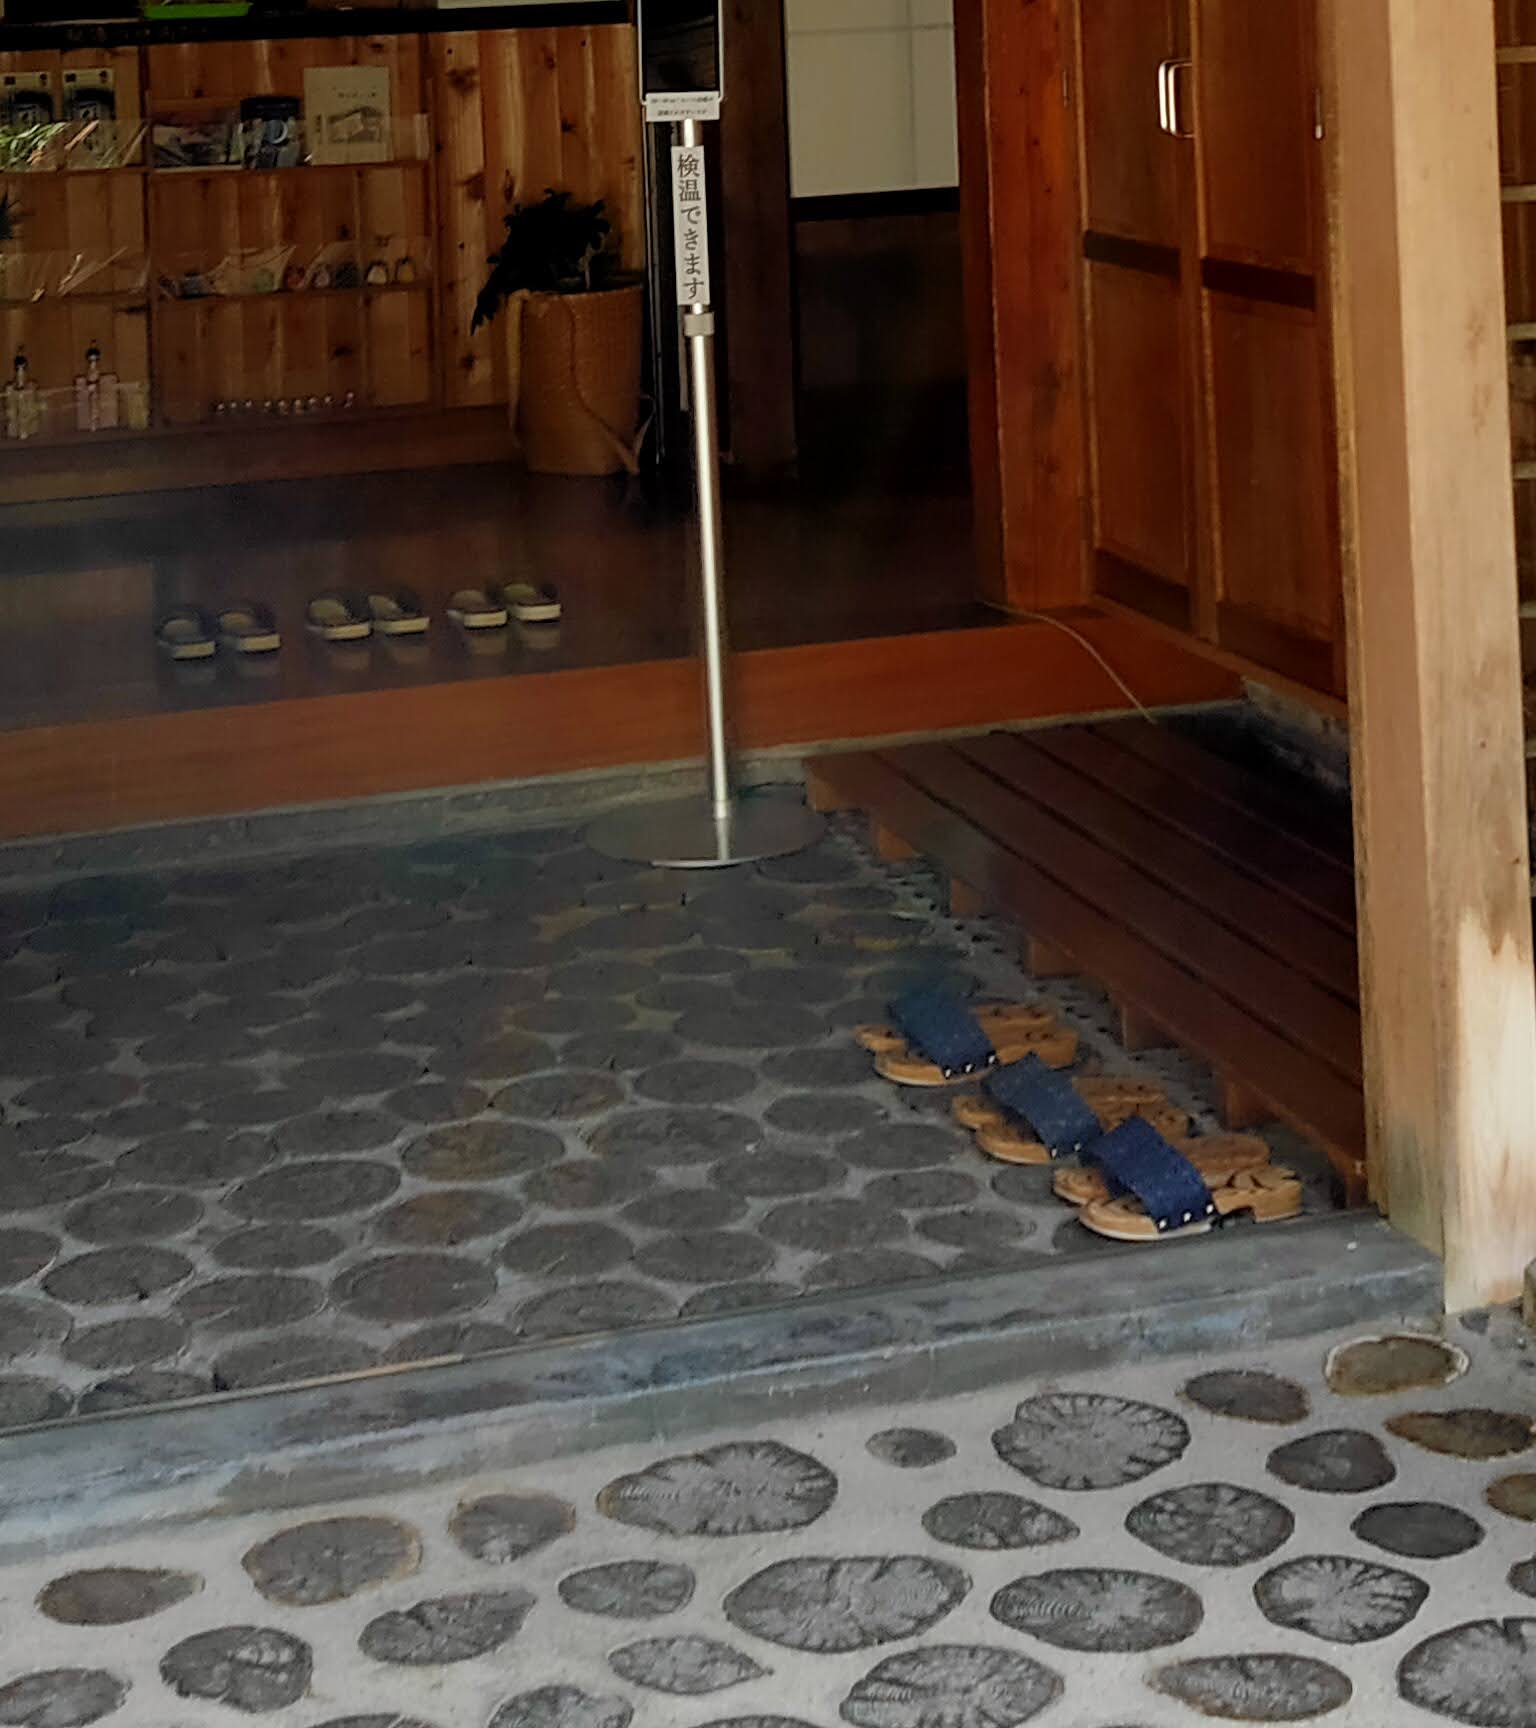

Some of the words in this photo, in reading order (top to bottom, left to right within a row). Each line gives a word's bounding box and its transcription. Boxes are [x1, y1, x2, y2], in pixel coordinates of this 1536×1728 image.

[676, 153, 705, 300] 検温できます
